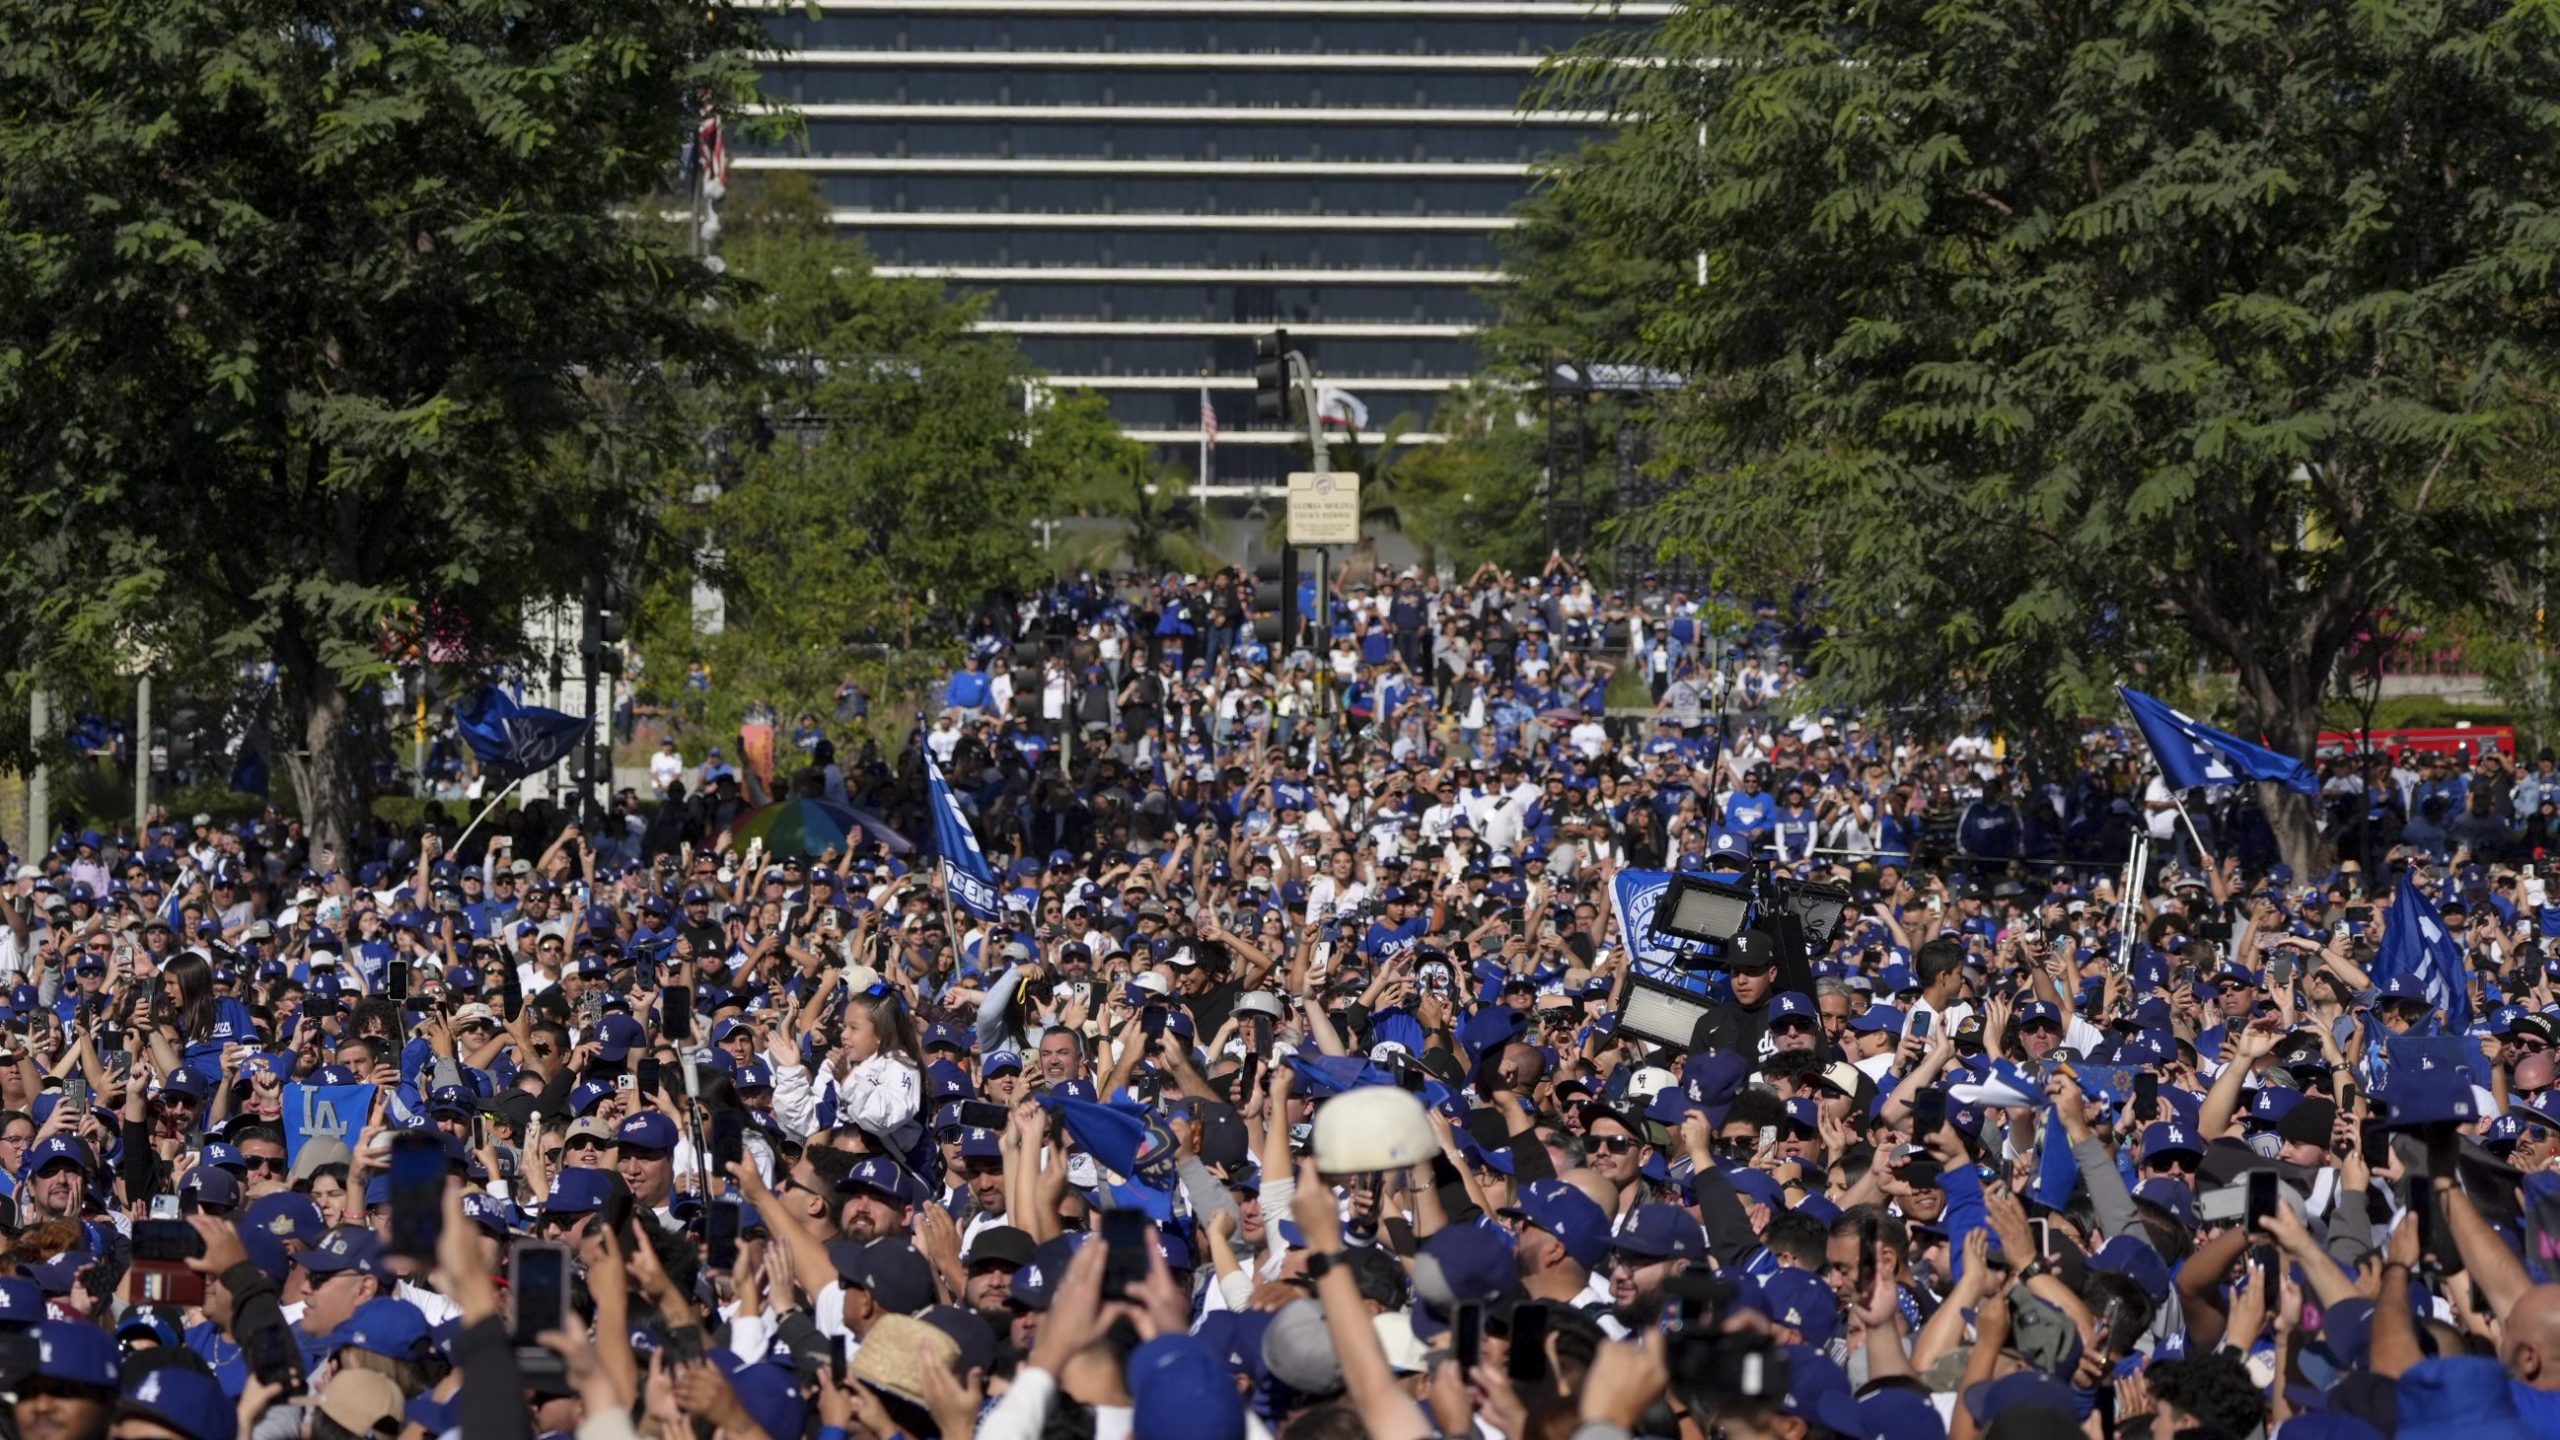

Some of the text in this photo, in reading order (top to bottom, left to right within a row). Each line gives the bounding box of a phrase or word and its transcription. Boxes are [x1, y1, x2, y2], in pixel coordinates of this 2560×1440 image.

[1782, 997, 1794, 1010] LA
[1166, 1014, 1175, 1026] LA
[937, 1025, 946, 1035] LA
[324, 1070, 338, 1084] LA
[745, 1070, 756, 1082] LA
[902, 1072, 912, 1087] LA
[586, 1082, 601, 1094] LA
[948, 1081, 959, 1091] LA
[1068, 1082, 1079, 1095] LA
[2260, 1092, 2271, 1109] LA
[300, 1085, 347, 1138] LA
[752, 1111, 766, 1125] LA
[2506, 1117, 2516, 1133] LA
[2169, 1125, 2183, 1143] LA
[51, 1138, 66, 1151] LA
[210, 1145, 225, 1158] LA
[862, 1161, 876, 1176] LA
[463, 1197, 479, 1215] LA
[1029, 1266, 1042, 1287] LA
[0, 1289, 10, 1307] A
[46, 1303, 64, 1320] LA
